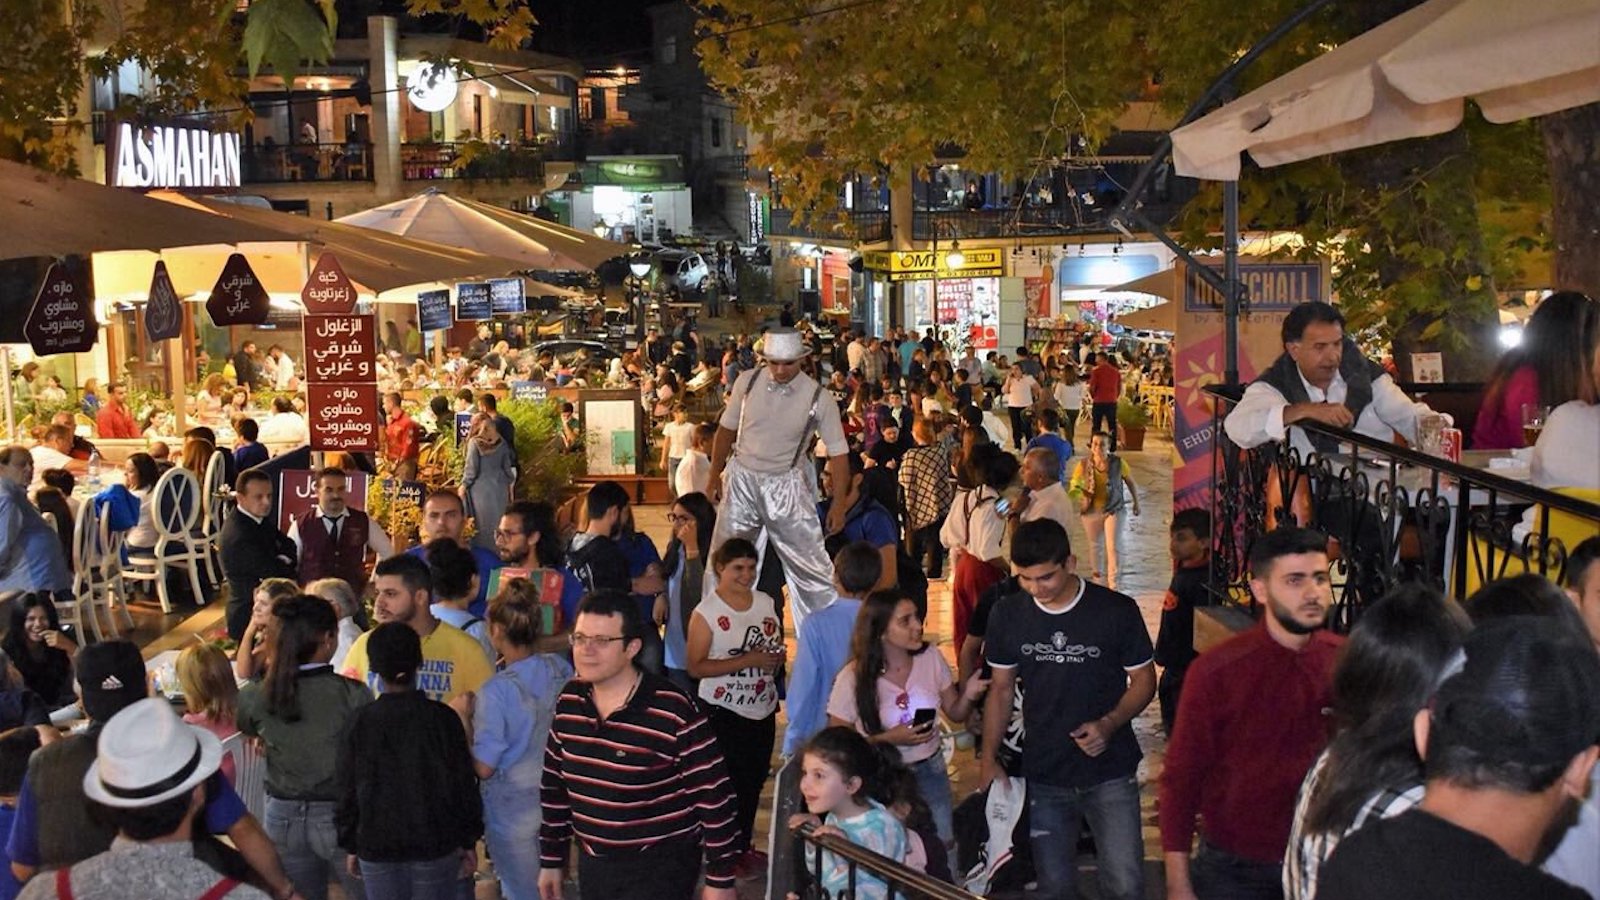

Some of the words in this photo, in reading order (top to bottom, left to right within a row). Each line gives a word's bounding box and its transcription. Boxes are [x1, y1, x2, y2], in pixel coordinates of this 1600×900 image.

[116, 122, 241, 187] ASMAHAN
[222, 275, 253, 292] شرقي
[318, 271, 338, 284] كبة
[234, 288, 242, 300] و
[309, 287, 350, 303] زغرتاوية
[44, 298, 79, 320] مشاوي
[226, 300, 251, 316] غربي
[39, 316, 85, 335] ومشروب
[316, 318, 362, 337] الزغلول
[313, 340, 363, 363] شرقي
[316, 359, 354, 380] غربي
[358, 361, 369, 376] و
[320, 403, 363, 421] مشاوي
[315, 419, 373, 435] ومشروب
[1066, 655, 1086, 663] ITALY
